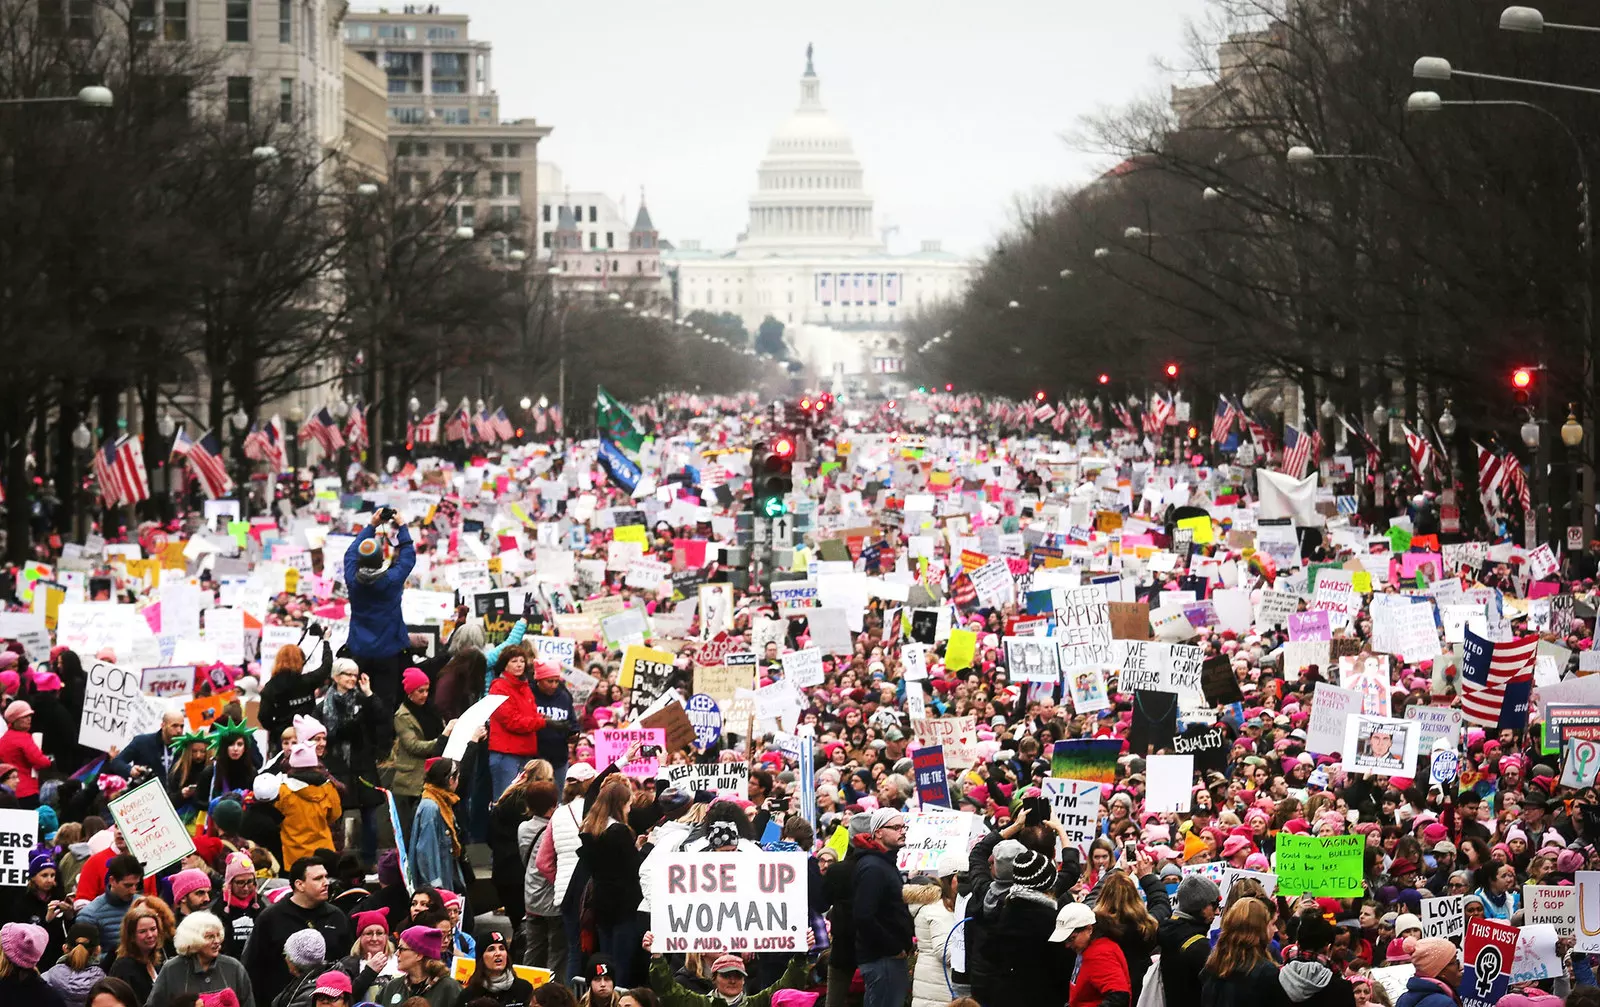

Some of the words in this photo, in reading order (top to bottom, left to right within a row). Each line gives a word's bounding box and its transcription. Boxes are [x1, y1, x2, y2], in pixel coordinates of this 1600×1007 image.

[1320, 580, 1353, 592] DIVERSITY
[772, 588, 818, 600] STRONGER
[1063, 588, 1100, 606] KEEP
[1315, 600, 1348, 613] AMERICA
[1055, 603, 1110, 627] RAPISTS
[1061, 627, 1088, 646] OFF
[1092, 623, 1110, 648] MY
[1062, 644, 1114, 666] CAMPUS
[1127, 641, 1148, 657] WE
[634, 659, 674, 677] STOP
[1123, 657, 1146, 669] ARE
[90, 664, 139, 698] GOD
[1122, 670, 1160, 684] CITIZENS
[1170, 673, 1199, 691] BACK
[689, 695, 715, 710] KEEP
[1316, 698, 1345, 711] RIGHTS
[1418, 711, 1429, 720] MY
[1430, 712, 1447, 722] BODY
[913, 720, 954, 735] UNITED
[961, 719, 974, 731] WE
[603, 731, 655, 741] WOMENS
[1172, 728, 1222, 753] EQUALITY
[669, 764, 693, 781] KEEP
[695, 764, 719, 777] YOUR
[724, 762, 748, 778] LAWS
[919, 771, 932, 786] ARE
[932, 769, 944, 784] THE
[690, 778, 710, 792] OFF
[717, 777, 738, 790] OUR
[1055, 795, 1077, 808] I'M
[1057, 812, 1088, 826] ITH
[1065, 830, 1084, 842] ER
[1320, 837, 1359, 848] VAGINA
[1328, 849, 1362, 858] BULLETS
[668, 863, 737, 894] RISE
[758, 862, 796, 893] UP
[1277, 876, 1358, 890] REGULATED
[1538, 889, 1572, 898] TRUMP
[1428, 897, 1463, 919] LOVE
[1543, 901, 1565, 910] GOP
[667, 900, 798, 933] WOMAN.
[1531, 915, 1564, 924] HANDS
[1423, 921, 1444, 938] NOT
[1445, 916, 1463, 934] HATE
[1471, 923, 1491, 938] THIS
[1491, 928, 1517, 945] PUSSY
[667, 937, 689, 951] NO
[693, 937, 728, 952] MUD,
[731, 937, 748, 949] NO
[753, 936, 796, 949] LOTUS
